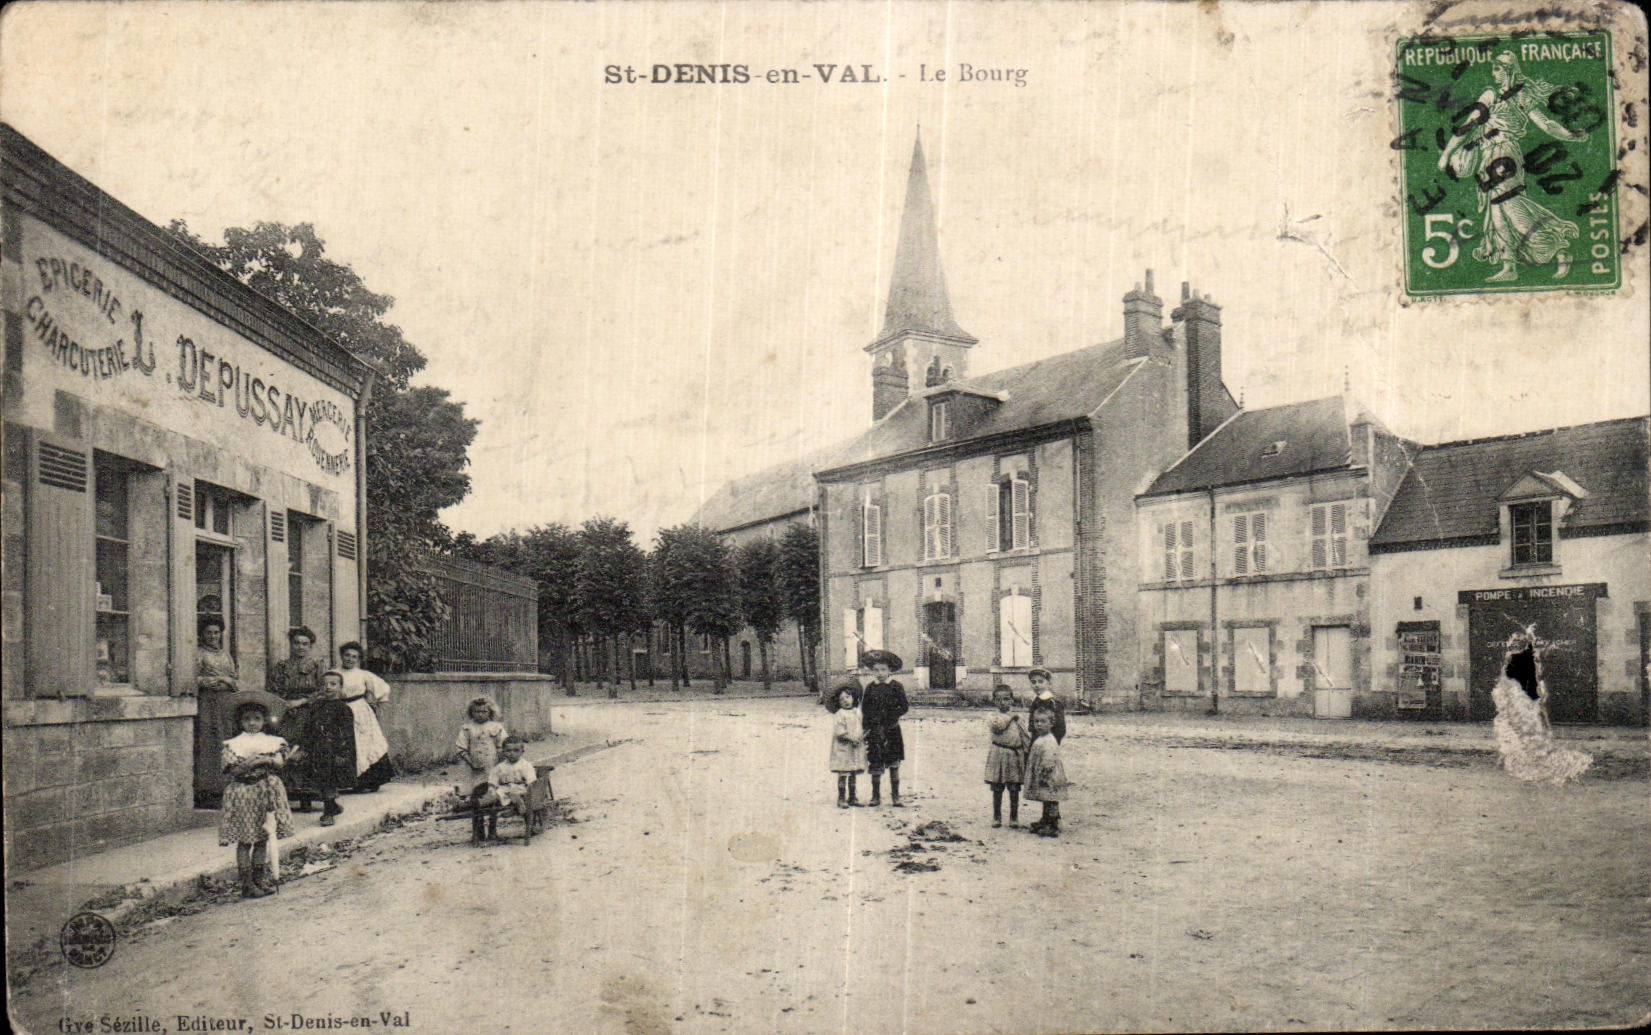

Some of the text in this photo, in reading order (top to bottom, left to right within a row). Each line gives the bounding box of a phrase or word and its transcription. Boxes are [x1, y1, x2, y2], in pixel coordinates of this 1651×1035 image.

[1589, 191, 1611, 275] POSTES
[35, 257, 121, 325] EPICERIE
[26, 295, 130, 381] CHARCUTERIE
[176, 333, 308, 444] DEPUSSAY
[308, 399, 353, 443] MERCERIE
[1475, 590, 1512, 601] POMPE
[1529, 585, 1585, 600] INCENDIE
